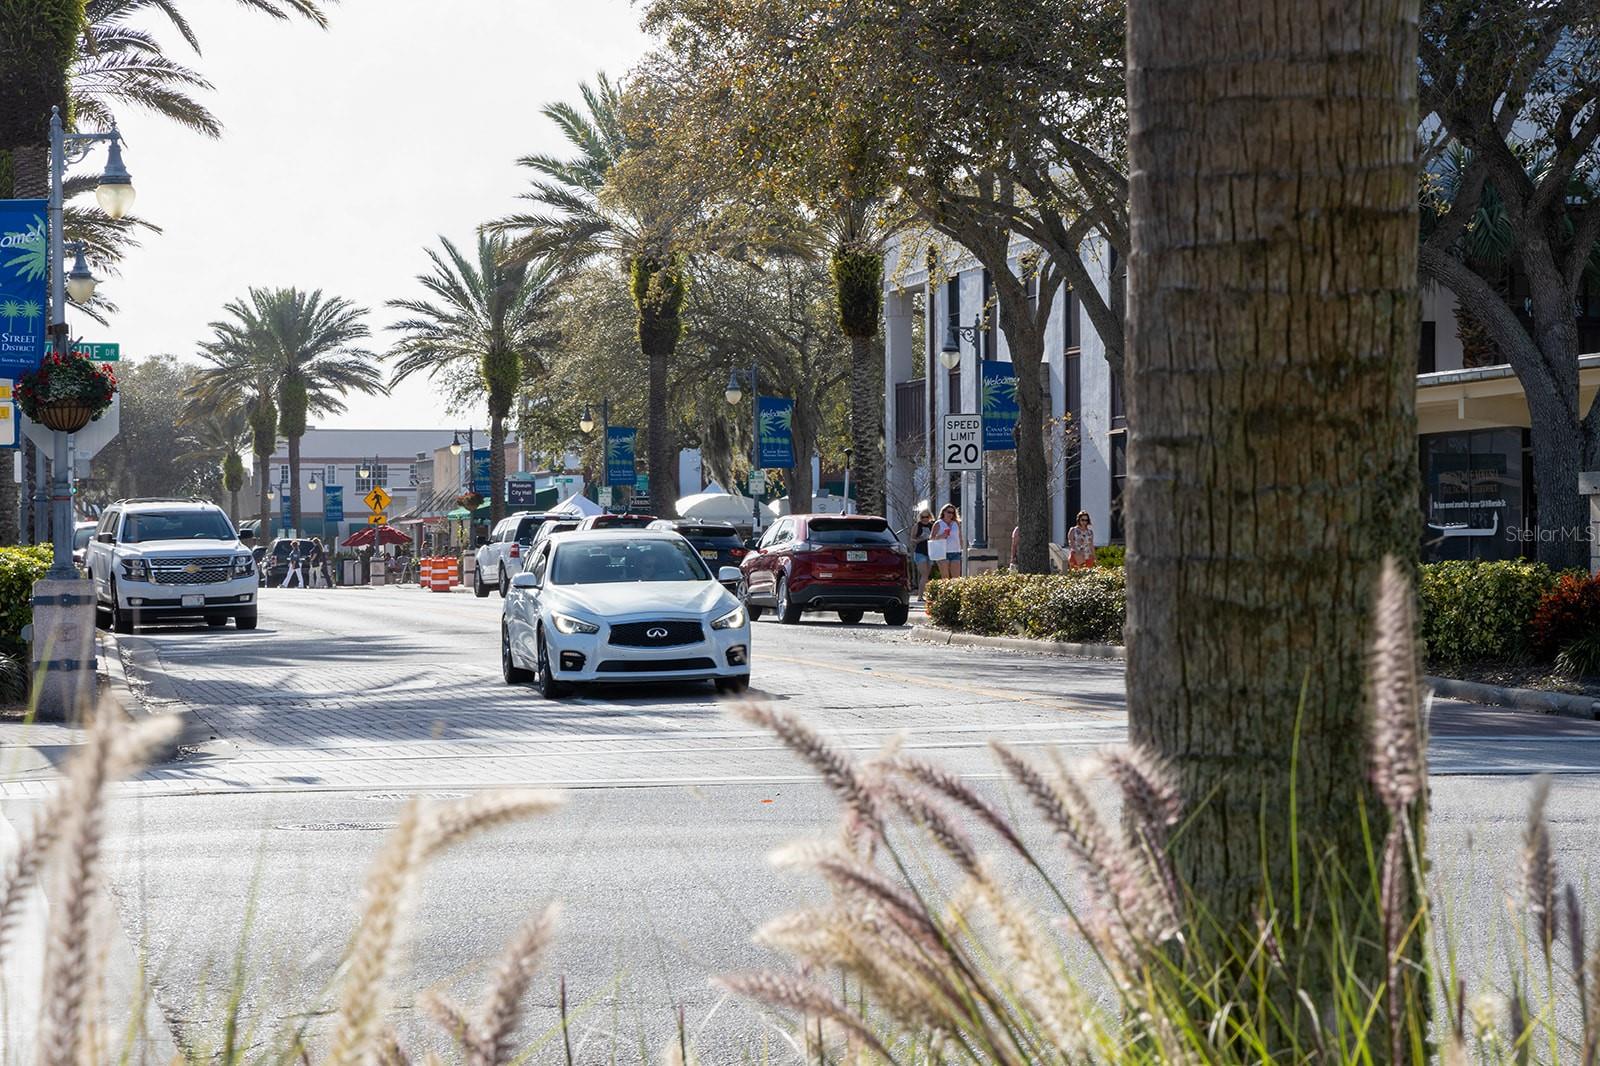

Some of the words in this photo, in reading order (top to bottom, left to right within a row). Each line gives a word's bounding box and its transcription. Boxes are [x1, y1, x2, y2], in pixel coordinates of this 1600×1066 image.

[0, 224, 41, 248] ome!
[1, 332, 36, 343] STREET
[1, 343, 35, 352] DISTRICT
[947, 420, 980, 430] SPEED
[950, 432, 976, 441] LIMIT
[947, 443, 979, 464] 20
